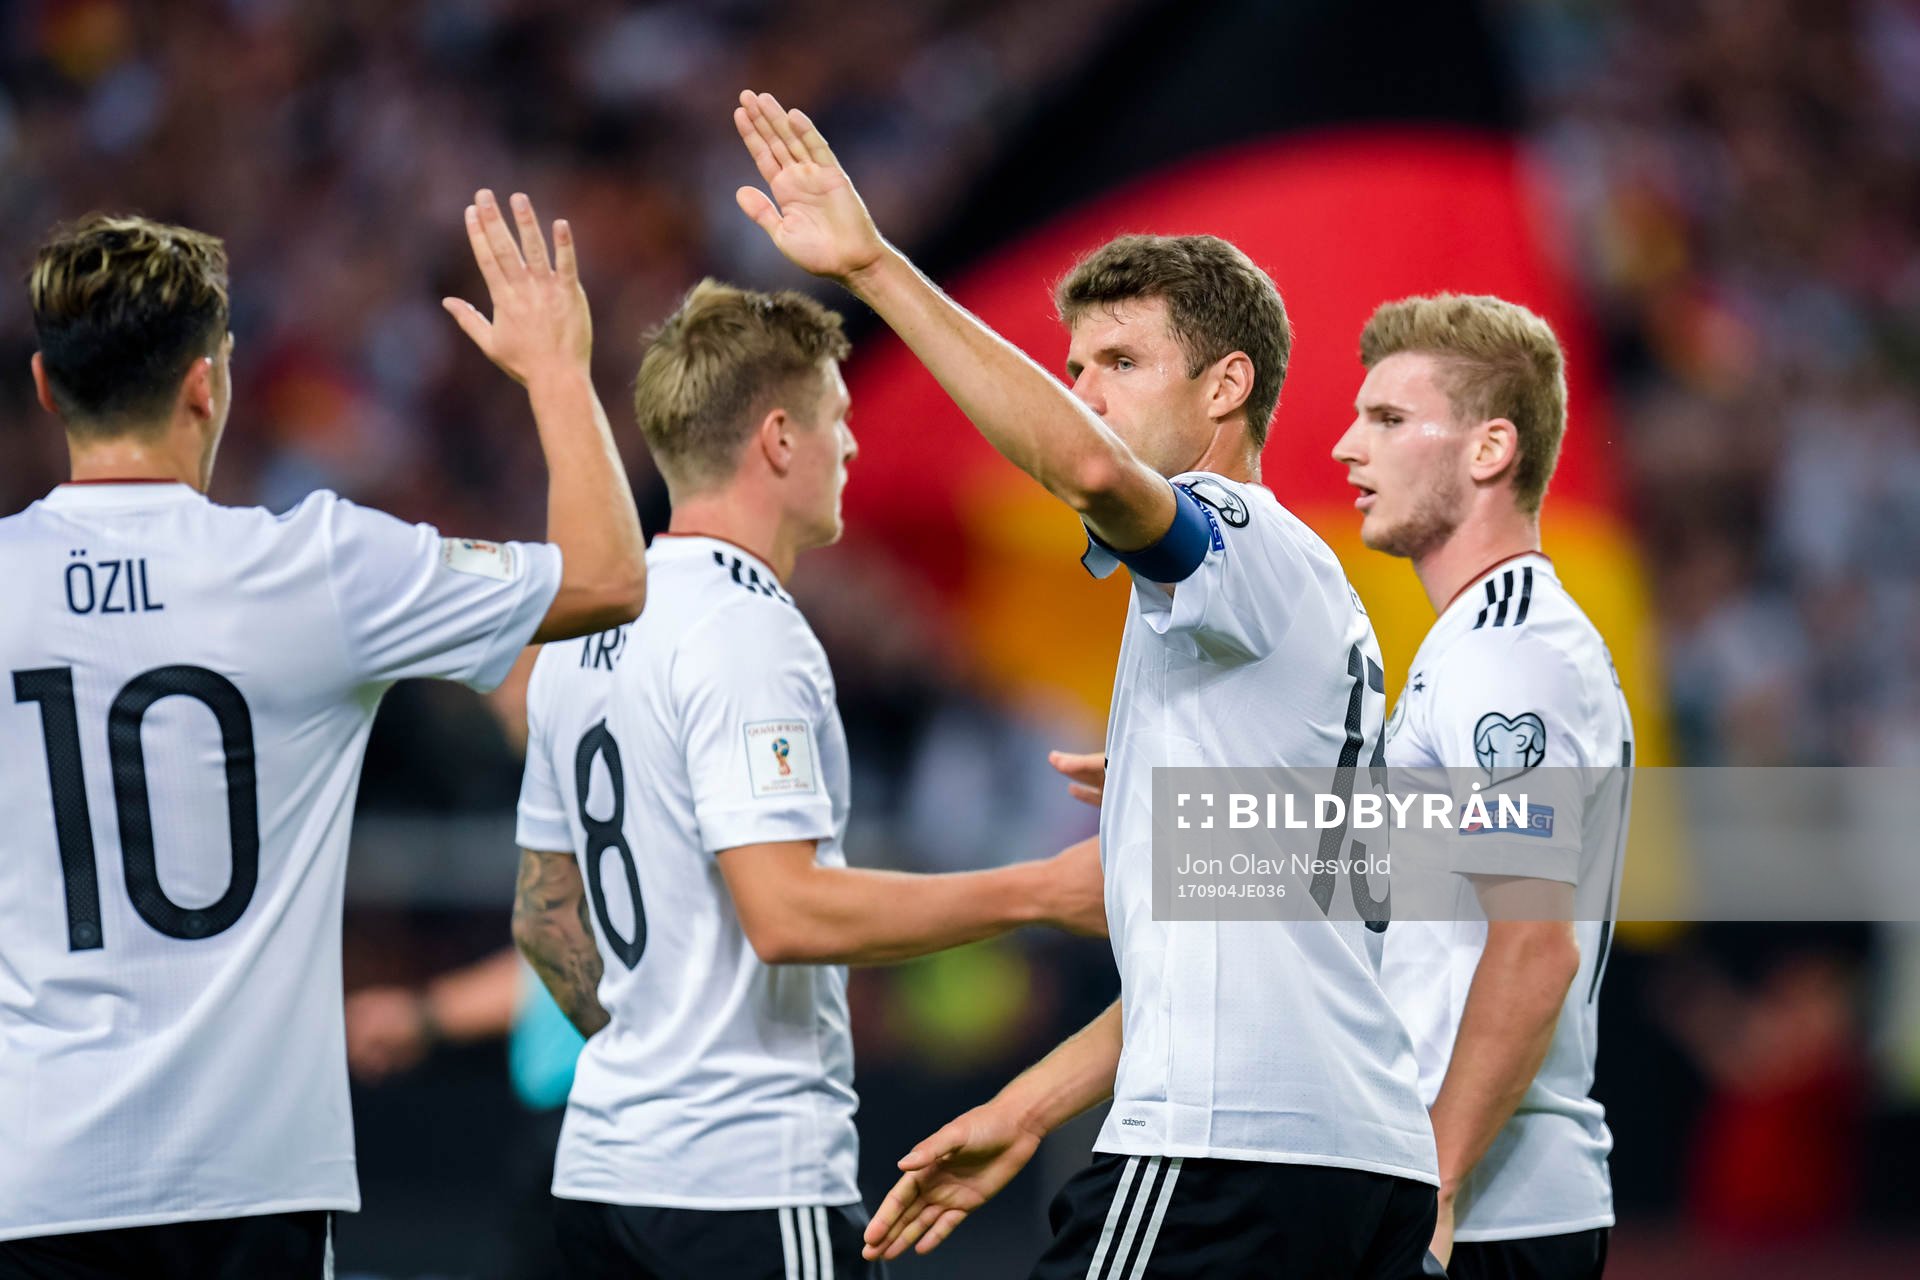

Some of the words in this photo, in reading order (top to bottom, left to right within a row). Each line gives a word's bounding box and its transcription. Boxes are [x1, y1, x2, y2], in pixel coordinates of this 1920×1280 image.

[65, 549, 164, 615] ÖZIL
[580, 624, 627, 671] KR
[11, 664, 260, 952] 10
[575, 717, 648, 970] 8
[1122, 1118, 1146, 1127] adizero
